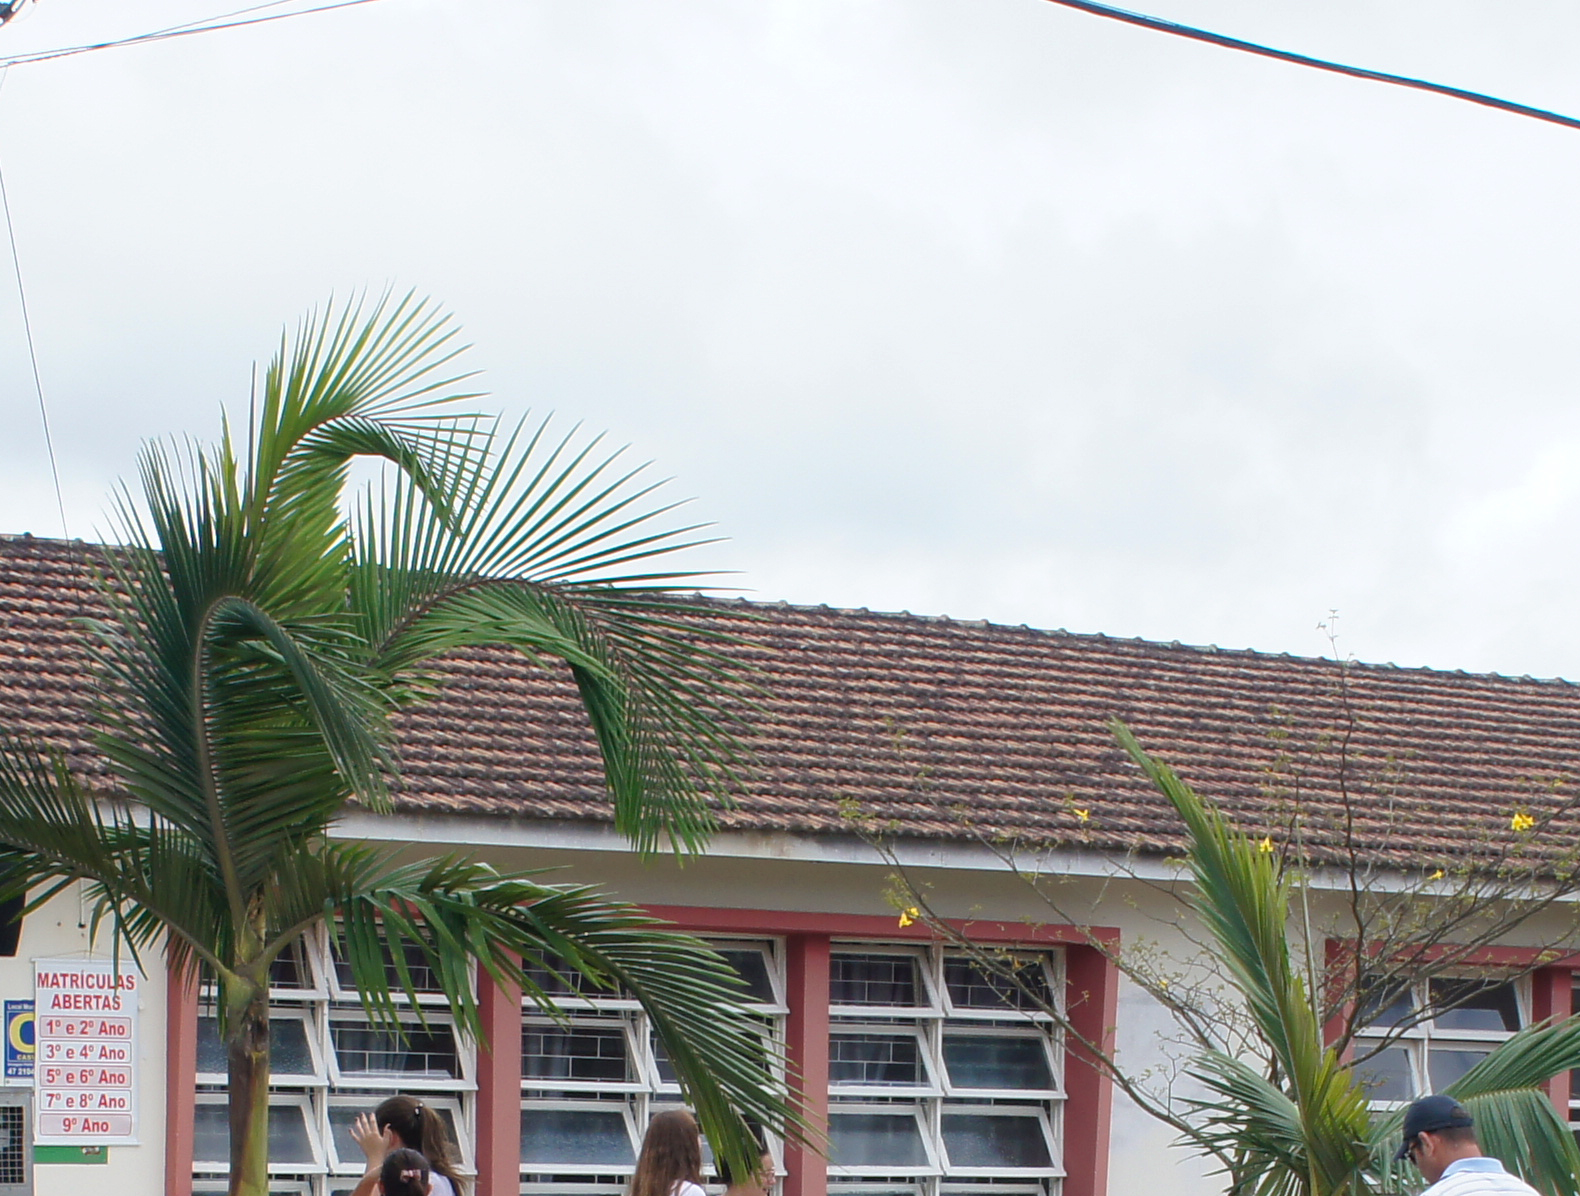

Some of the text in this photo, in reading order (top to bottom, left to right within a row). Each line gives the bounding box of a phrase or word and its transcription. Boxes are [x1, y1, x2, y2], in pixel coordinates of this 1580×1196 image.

[37, 969, 135, 990] MATRÍCULAS
[51, 994, 121, 1010] ABERTAS
[46, 1020, 125, 1035] 1º e 2º Ano
[46, 1044, 125, 1060] 3º e 4º Ano
[46, 1069, 125, 1084] 5º e 6º Ano
[46, 1093, 125, 1108] 7º e 8º Ano
[63, 1118, 109, 1132] 9º Ano
